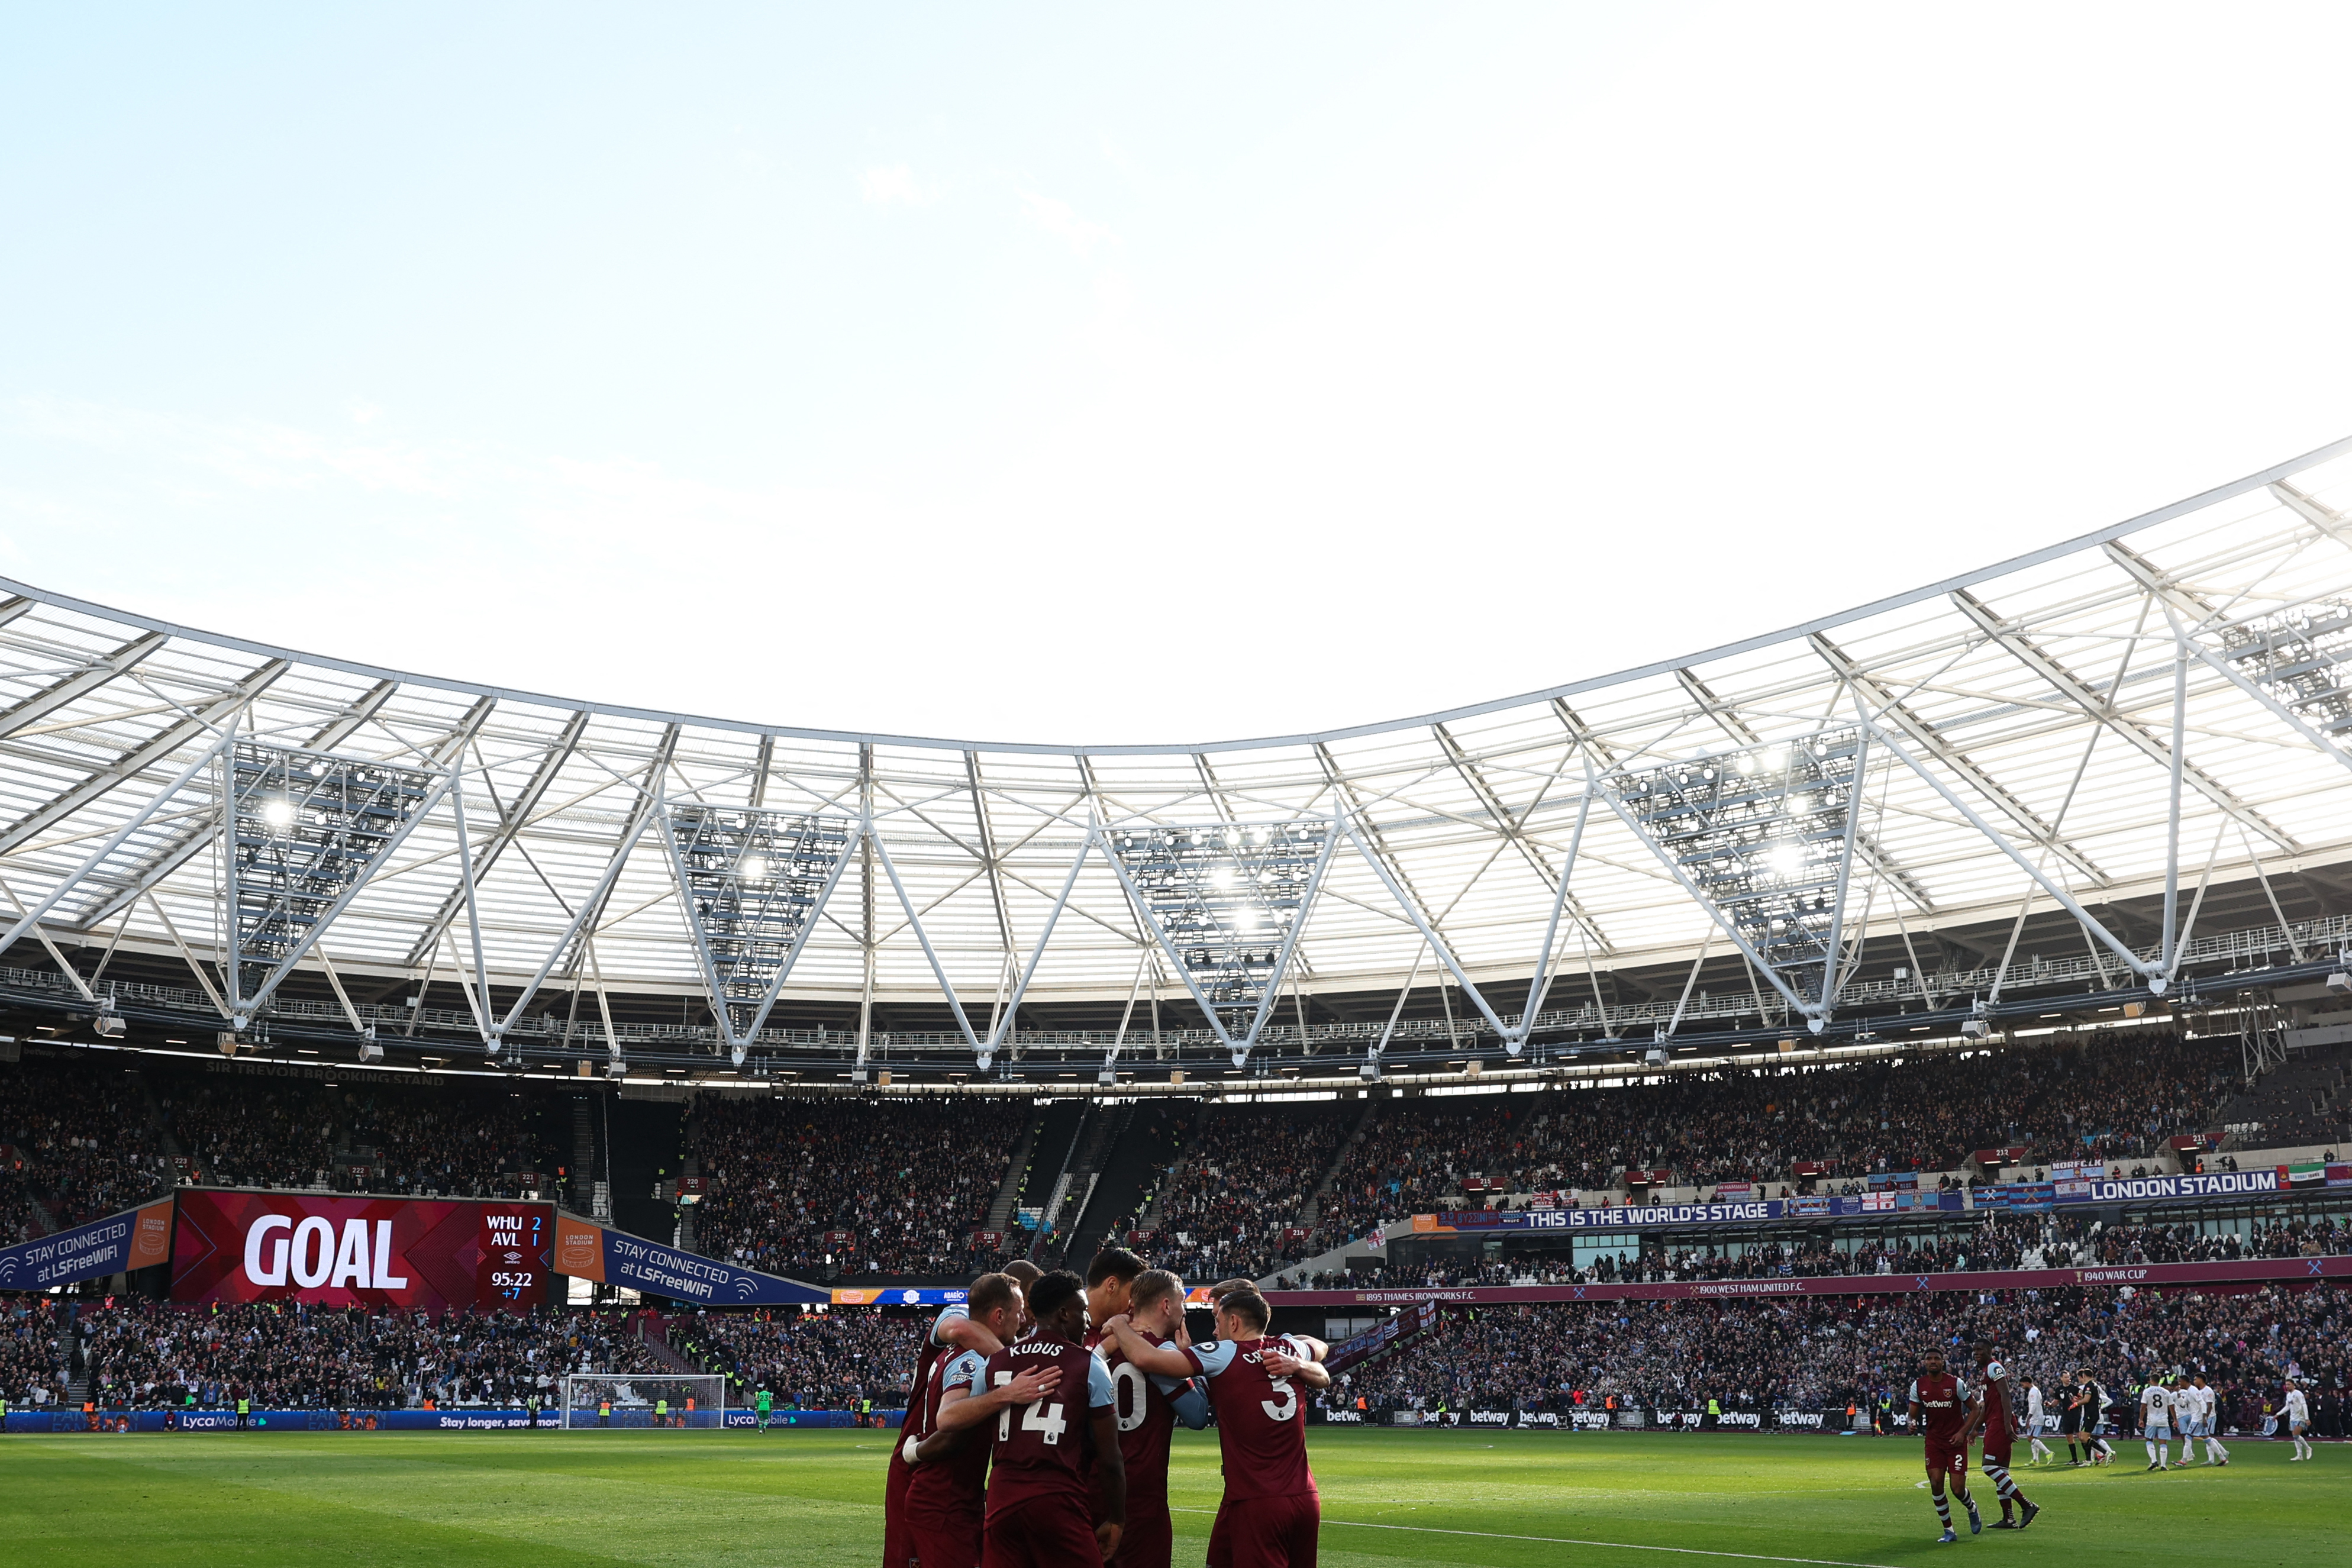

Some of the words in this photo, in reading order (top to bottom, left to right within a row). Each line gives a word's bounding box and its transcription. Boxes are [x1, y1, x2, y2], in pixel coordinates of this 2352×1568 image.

[24, 1047, 56, 1058] betway
[206, 1062, 230, 1073] SIR
[236, 1064, 299, 1077] TREVOR
[304, 1068, 390, 1083] BROOKING
[393, 1074, 444, 1086] STAND
[557, 1083, 585, 1092] betway
[2091, 1177, 2176, 1200] LONDON
[2180, 1172, 2277, 1195] STADIUM
[1527, 1212, 1566, 1227] THIS
[1570, 1211, 1586, 1226] IS
[1589, 1209, 1623, 1225] THE
[1627, 1205, 1708, 1224] WORLD'S
[1711, 1203, 1769, 1220] STAGE
[486, 1216, 522, 1230] WHU
[532, 1217, 541, 1230] 2
[25, 1244, 55, 1266] STAY
[58, 1222, 126, 1256] CONNECTED
[491, 1233, 521, 1246] AVL
[533, 1234, 537, 1246] 1
[244, 1215, 408, 1289] GOAL
[37, 1266, 50, 1283] at
[52, 1244, 118, 1278] LSFreeWIFI
[614, 1240, 649, 1260] STAY
[649, 1250, 729, 1284] CONNECTED
[492, 1272, 532, 1286] 95:22
[621, 1262, 635, 1276] at
[636, 1265, 713, 1298] LSFreeWIFI
[2085, 1271, 2105, 1281] 1940
[2105, 1270, 2126, 1280] WAR
[2128, 1269, 2147, 1279] CUP
[502, 1288, 521, 1300] +7
[1700, 1285, 1717, 1294] 1900
[1718, 1284, 1739, 1293] WEST
[1740, 1284, 1760, 1292] HAM
[1760, 1283, 1789, 1292] UNITED
[1790, 1282, 1805, 1291] F.C.
[1415, 1292, 1461, 1300] IRONWORKS
[1009, 1342, 1064, 1357] KUDUS
[1261, 1373, 1297, 1421] 3
[2153, 1394, 2163, 1408] 8
[994, 1370, 1067, 1445] 14
[1327, 1409, 1361, 1421] betwa
[440, 1417, 465, 1430] Stay
[467, 1417, 505, 1429] longer,
[1424, 1409, 1460, 1425] betay
[1470, 1409, 1509, 1425] betway
[1657, 1411, 1702, 1427] beway
[1955, 1454, 1963, 1466] 2
